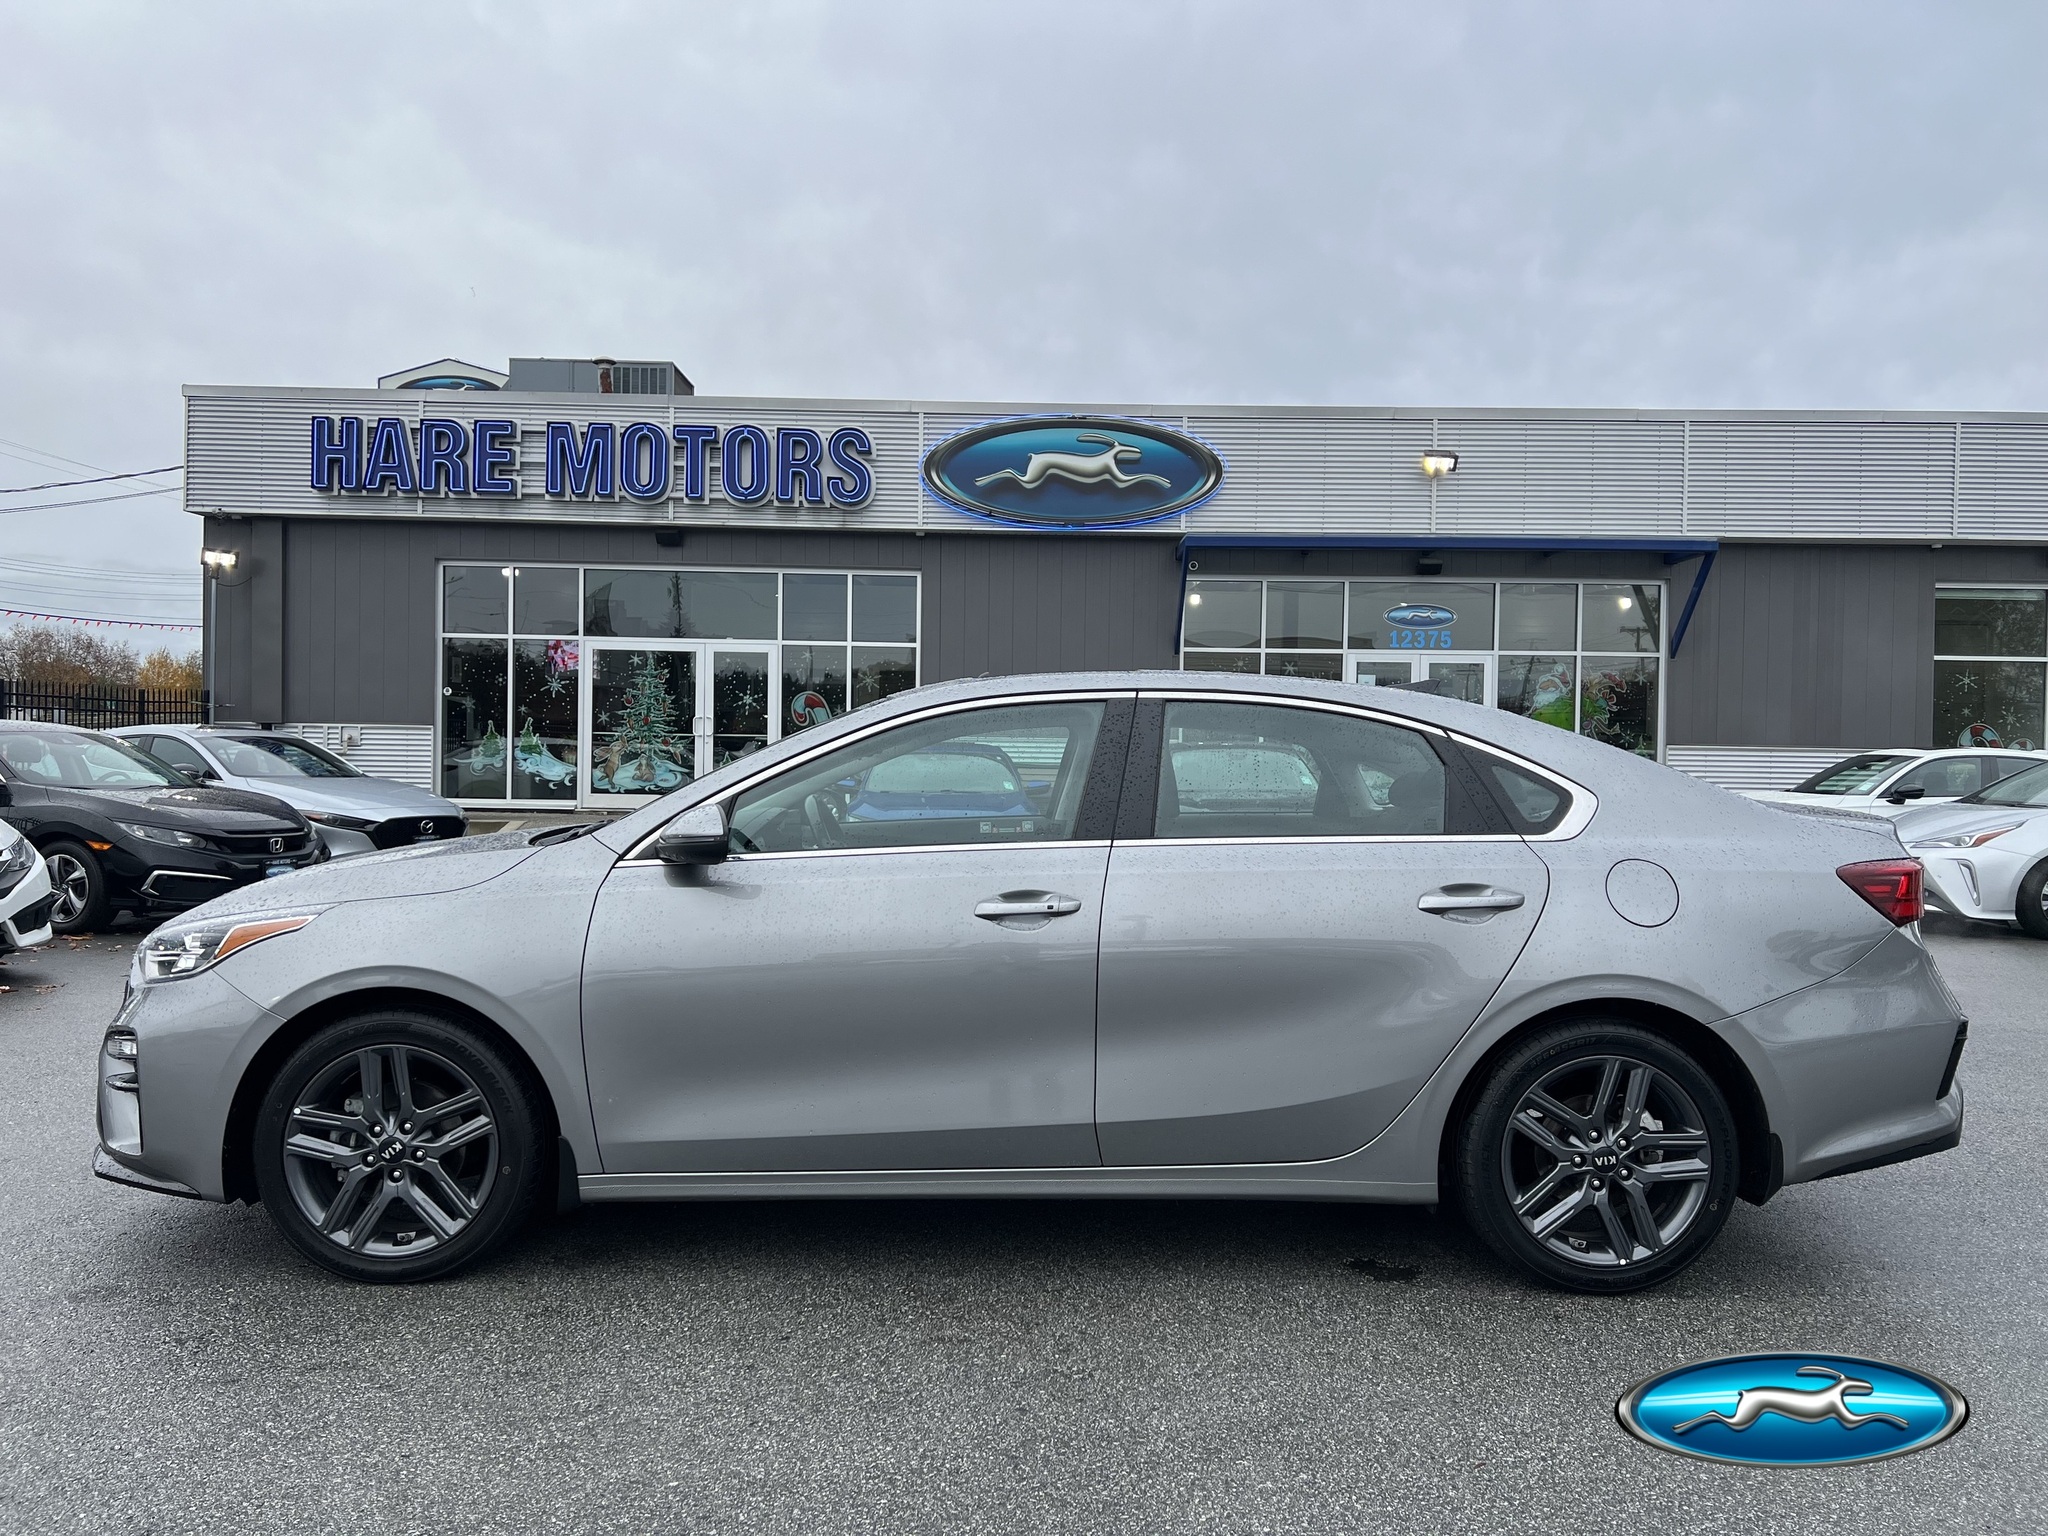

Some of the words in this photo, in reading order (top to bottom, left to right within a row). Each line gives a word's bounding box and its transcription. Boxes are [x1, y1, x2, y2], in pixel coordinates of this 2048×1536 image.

[311, 416, 520, 497] HARE
[546, 420, 874, 506] MOTORS
[1389, 630, 1453, 648] 12375
[381, 1141, 403, 1159] KIA
[1594, 1155, 1617, 1167] KIA
